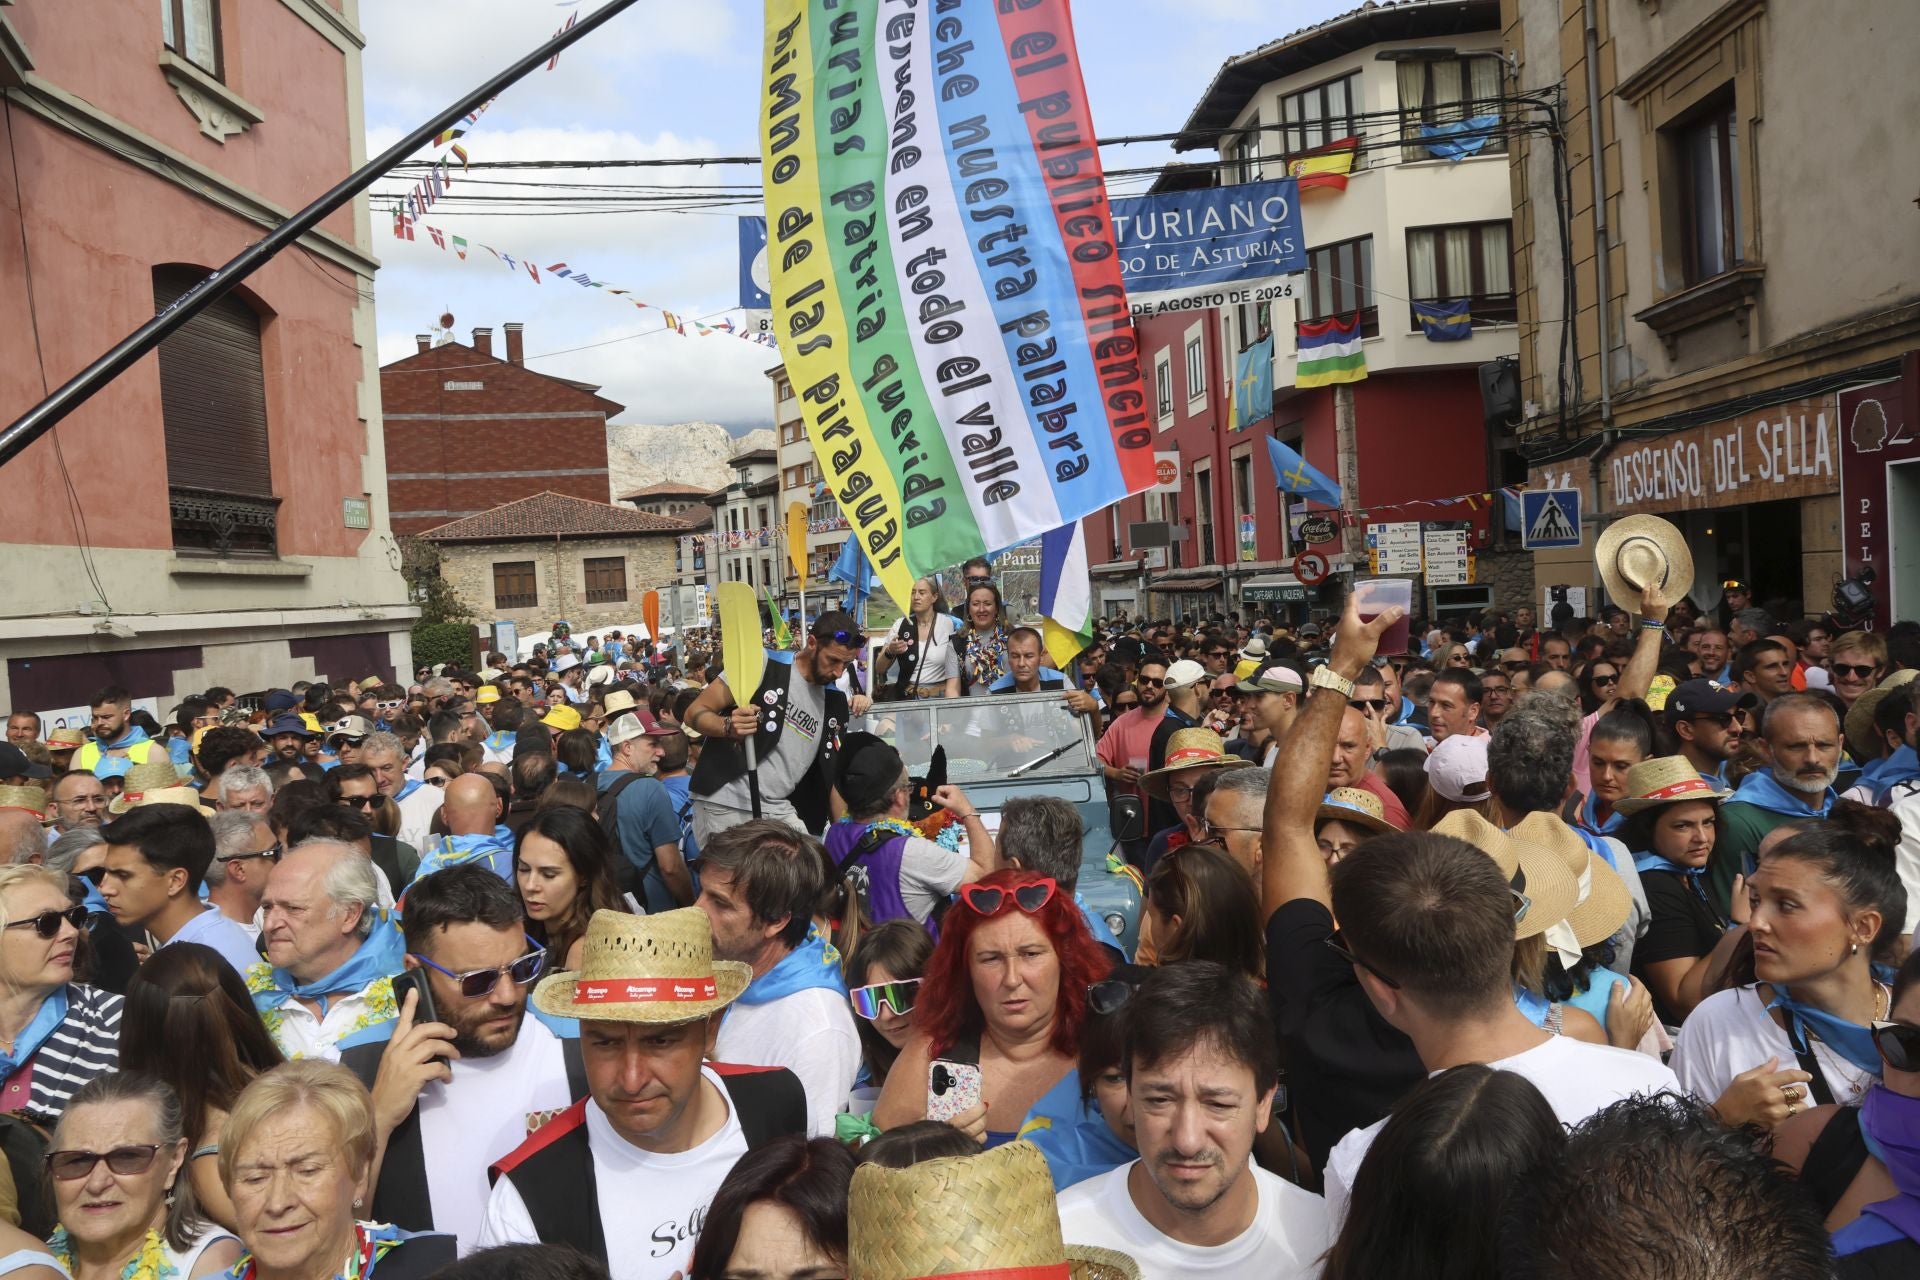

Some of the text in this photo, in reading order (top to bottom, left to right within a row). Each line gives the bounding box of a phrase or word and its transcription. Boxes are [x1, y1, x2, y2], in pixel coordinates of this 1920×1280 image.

[1010, 31, 1069, 77] el
[1016, 90, 1113, 263] publico
[777, 205, 814, 273] de
[895, 184, 935, 243] en
[1110, 196, 1289, 243] TURIANO
[1155, 254, 1181, 271] DE
[1192, 237, 1295, 267] ASTURIAS
[785, 278, 833, 357] las
[905, 246, 966, 344] todo
[948, 114, 1038, 302] nuestra
[1000, 309, 1090, 483] palabra
[1131, 302, 1153, 315] DE
[1157, 293, 1225, 314] AGOSTO
[1229, 289, 1250, 304] DE
[829, 180, 887, 343] patria
[861, 352, 947, 529] querida
[936, 355, 992, 397] el
[1081, 284, 1152, 450] silencio
[803, 372, 901, 569] piraguas
[956, 401, 1021, 507] valle
[1612, 412, 1833, 506] DESCENSO DEL SELLA
[1002, 550, 1041, 566] Paraí
[784, 702, 819, 734] ELLEROS
[650, 1204, 707, 1258] Sell
